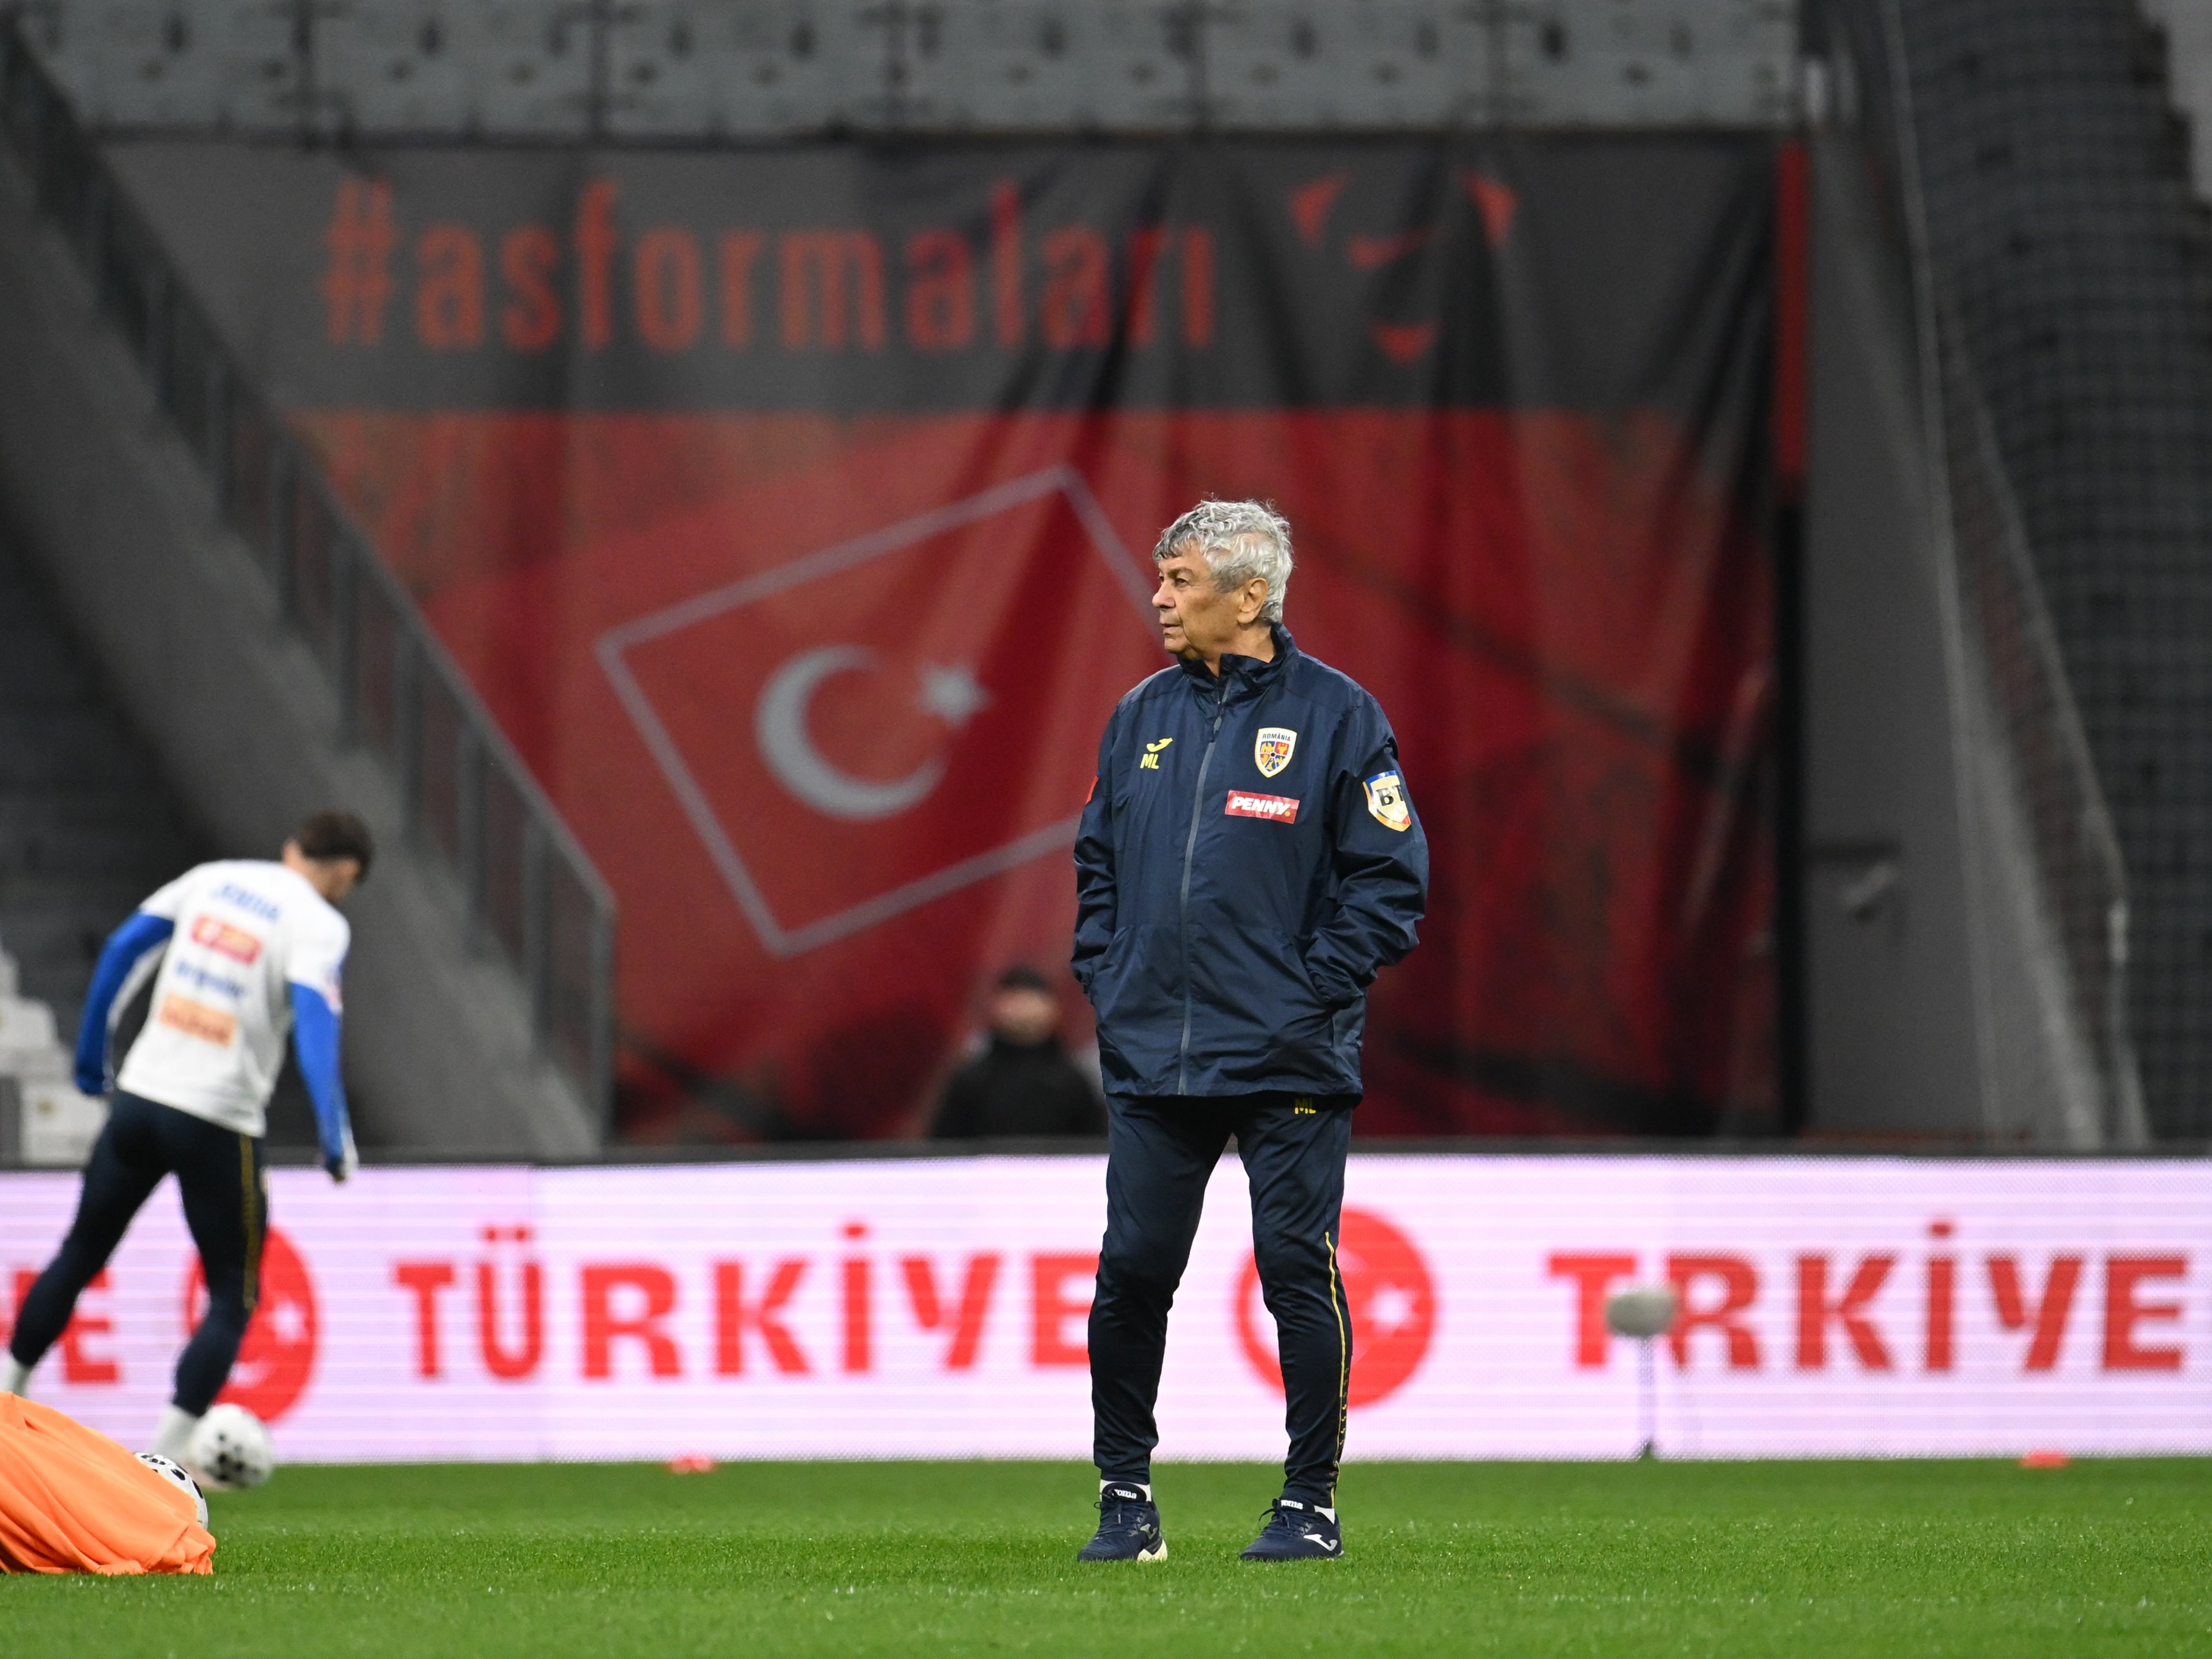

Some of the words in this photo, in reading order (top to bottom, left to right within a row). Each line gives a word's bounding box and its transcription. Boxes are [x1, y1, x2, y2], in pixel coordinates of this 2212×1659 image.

[1140, 753, 1160, 770] ML
[396, 1224, 1100, 1379] TÜRKİYE
[1111, 1489, 1137, 1499] oma
[1281, 1500, 1303, 1510] oma
